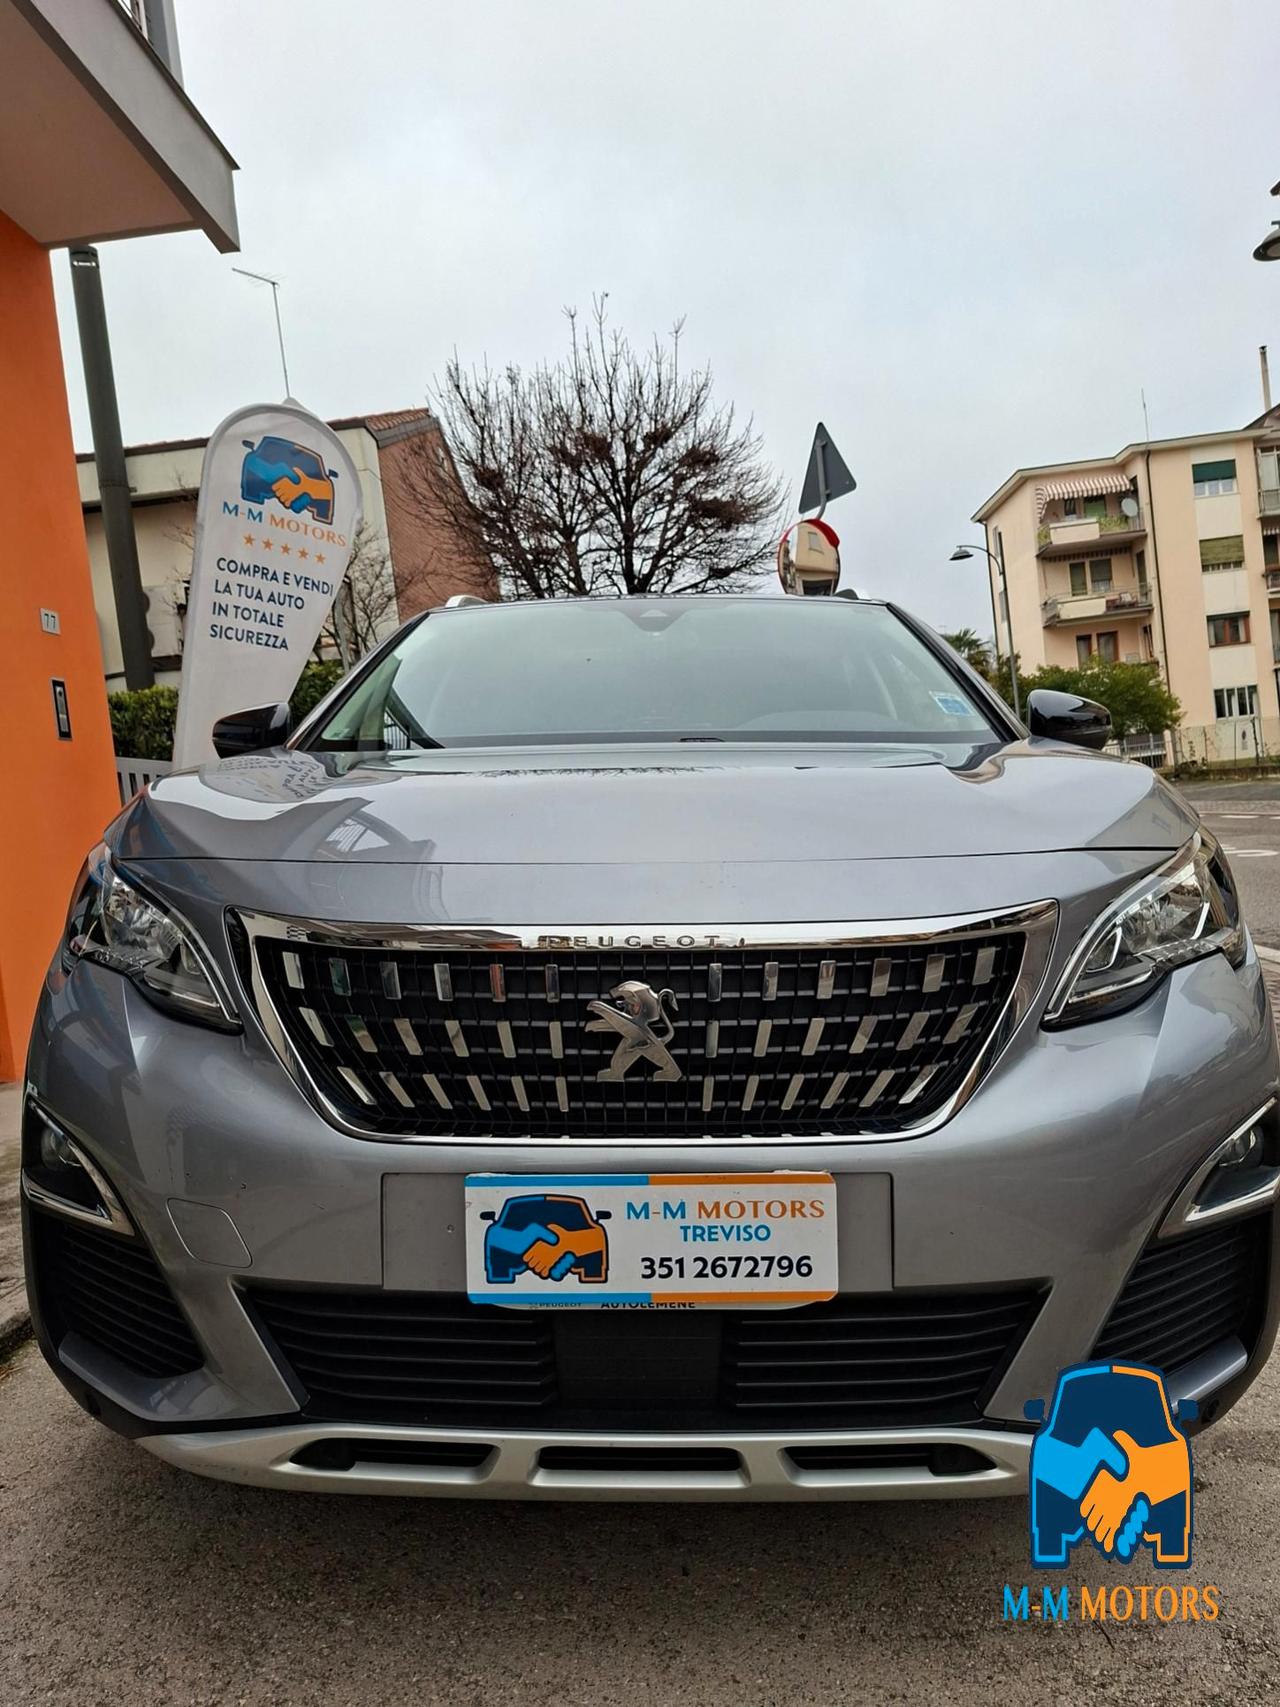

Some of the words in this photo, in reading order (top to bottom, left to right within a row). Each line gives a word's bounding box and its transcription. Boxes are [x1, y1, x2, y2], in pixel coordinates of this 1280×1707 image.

[222, 501, 263, 523] M-M
[269, 514, 346, 547] MOTORS
[216, 557, 279, 583] COMPRA
[283, 572, 291, 586] E
[294, 574, 334, 597] VENDI
[214, 579, 233, 595] LA
[236, 583, 264, 602] TUA
[267, 592, 305, 610] AUTO
[212, 601, 229, 617] IN
[233, 605, 285, 628] TOTALE
[210, 624, 289, 650] SICUREZZA
[546, 935, 720, 948] PEUGEOT
[626, 1200, 686, 1220] M-M
[697, 1199, 825, 1219] MOTORS
[680, 1224, 771, 1242] TREVISO
[641, 1256, 685, 1279] 351
[693, 1255, 813, 1278] 2672796
